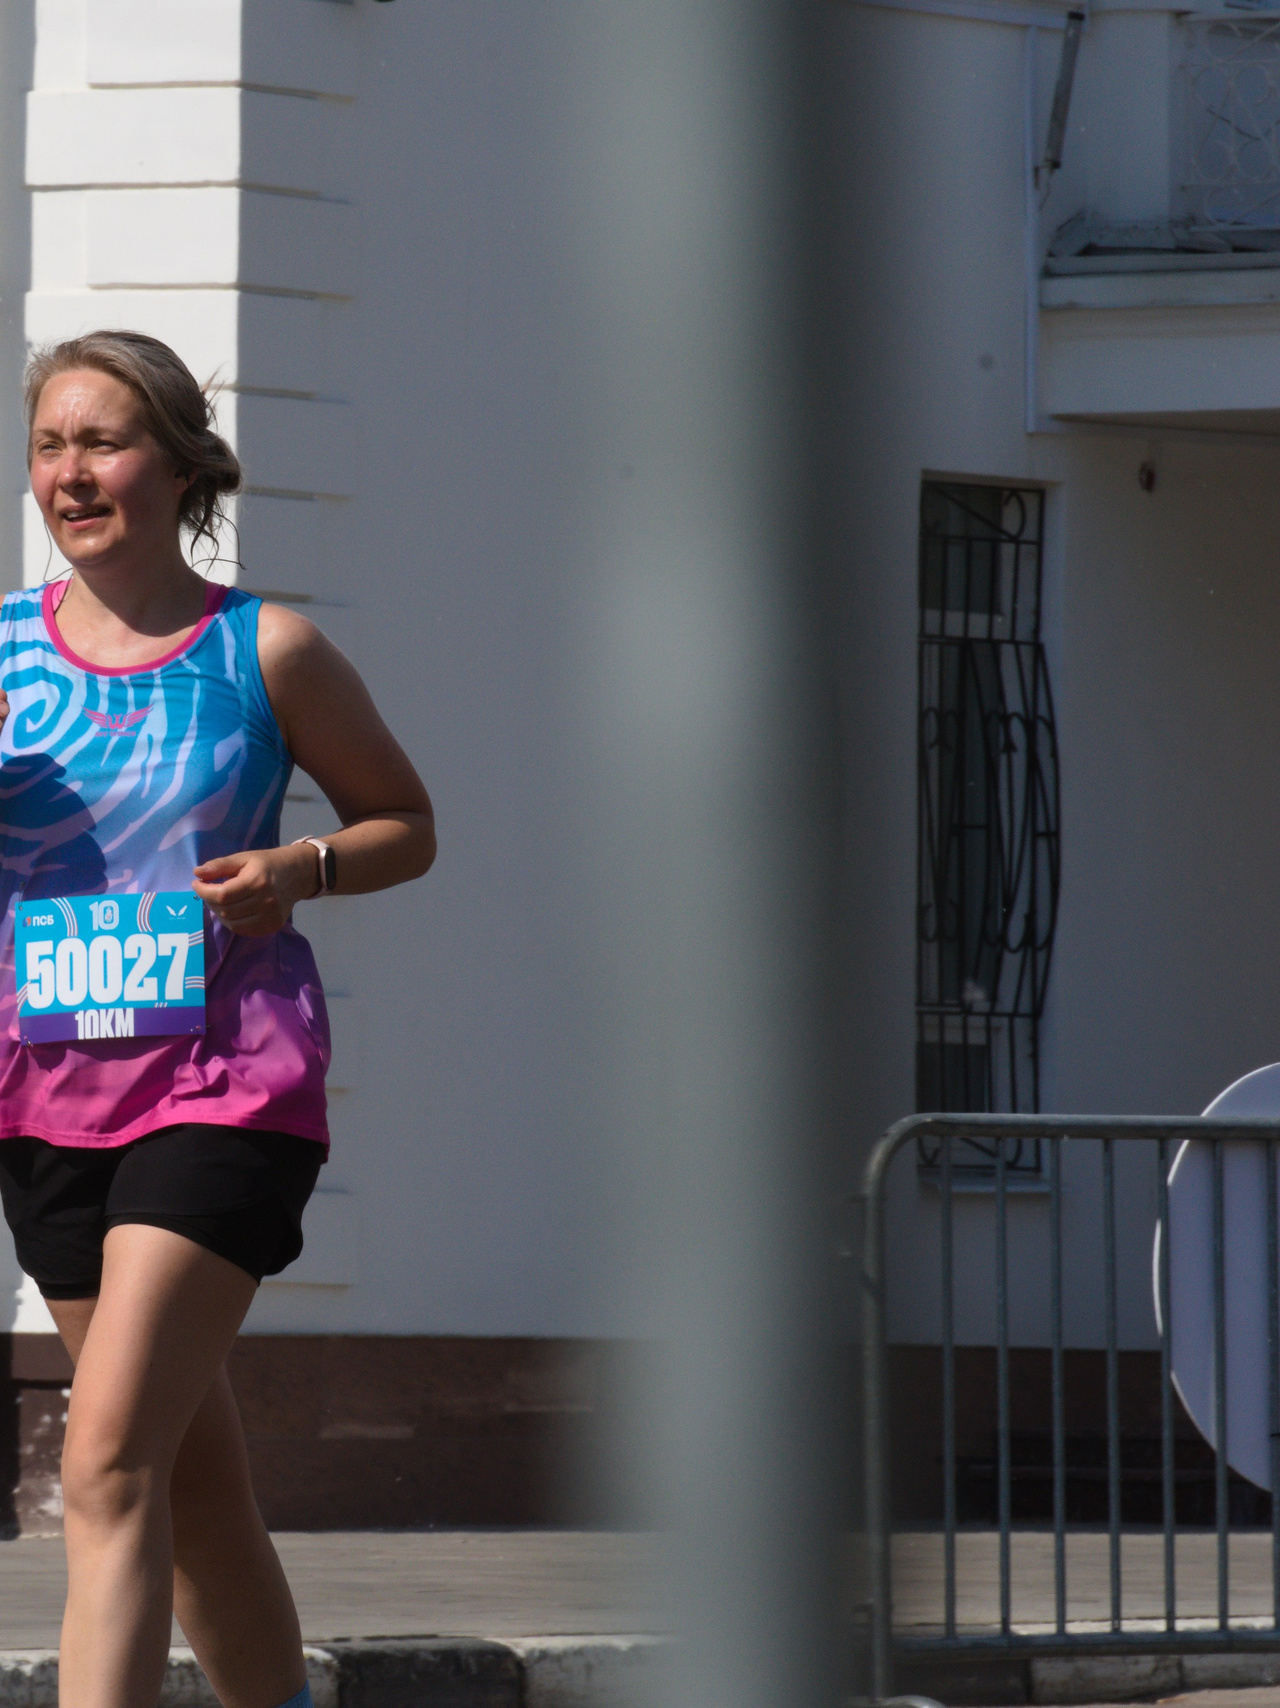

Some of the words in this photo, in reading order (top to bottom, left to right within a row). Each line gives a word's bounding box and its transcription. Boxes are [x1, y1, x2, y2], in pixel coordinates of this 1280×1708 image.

[32, 914, 54, 927] ПСБ
[88, 899, 120, 931] 10
[26, 933, 190, 1010] 50027
